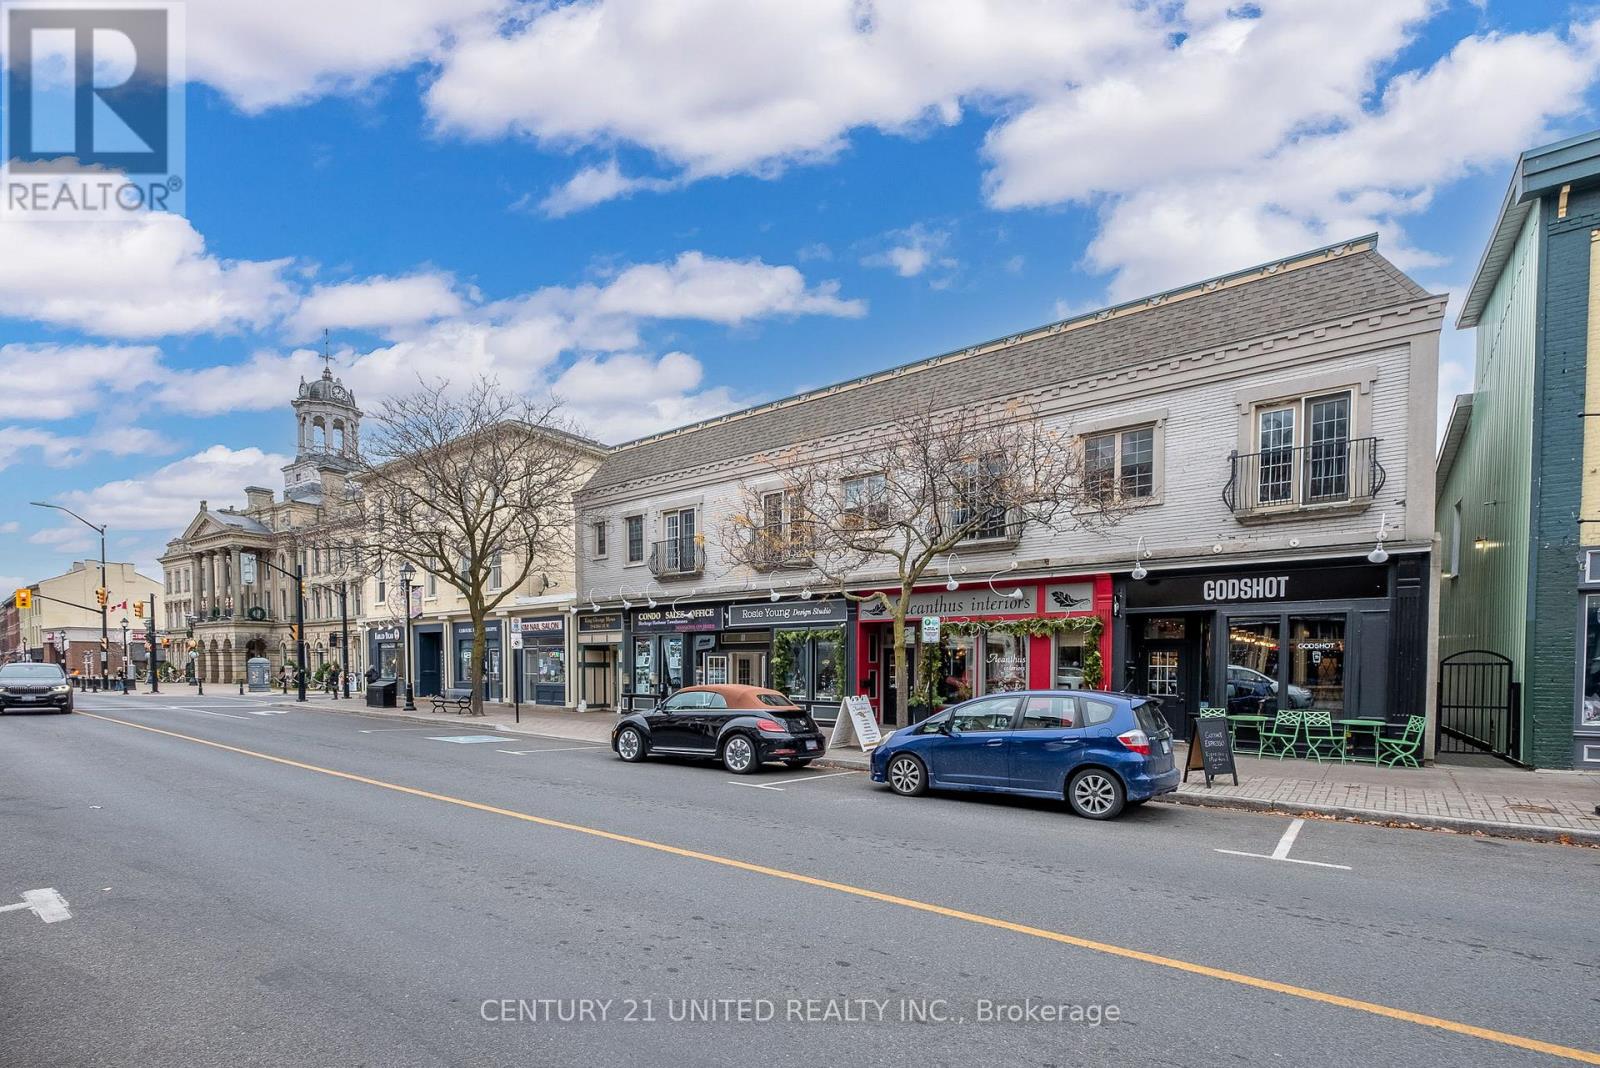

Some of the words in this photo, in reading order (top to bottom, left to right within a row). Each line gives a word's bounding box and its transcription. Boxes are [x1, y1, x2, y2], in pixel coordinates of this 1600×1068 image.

[1203, 576, 1289, 600] GODSHOT
[971, 597, 1031, 612] interiors
[638, 612, 661, 621] CONDO
[665, 611, 685, 619] SALES
[742, 609, 764, 619] Rosie
[765, 608, 791, 619] Young
[792, 608, 811, 617] Design
[812, 607, 832, 616] Studio
[541, 621, 560, 630] SALON
[1297, 642, 1335, 650] GODSHOT
[986, 653, 1026, 663] Acanthus
